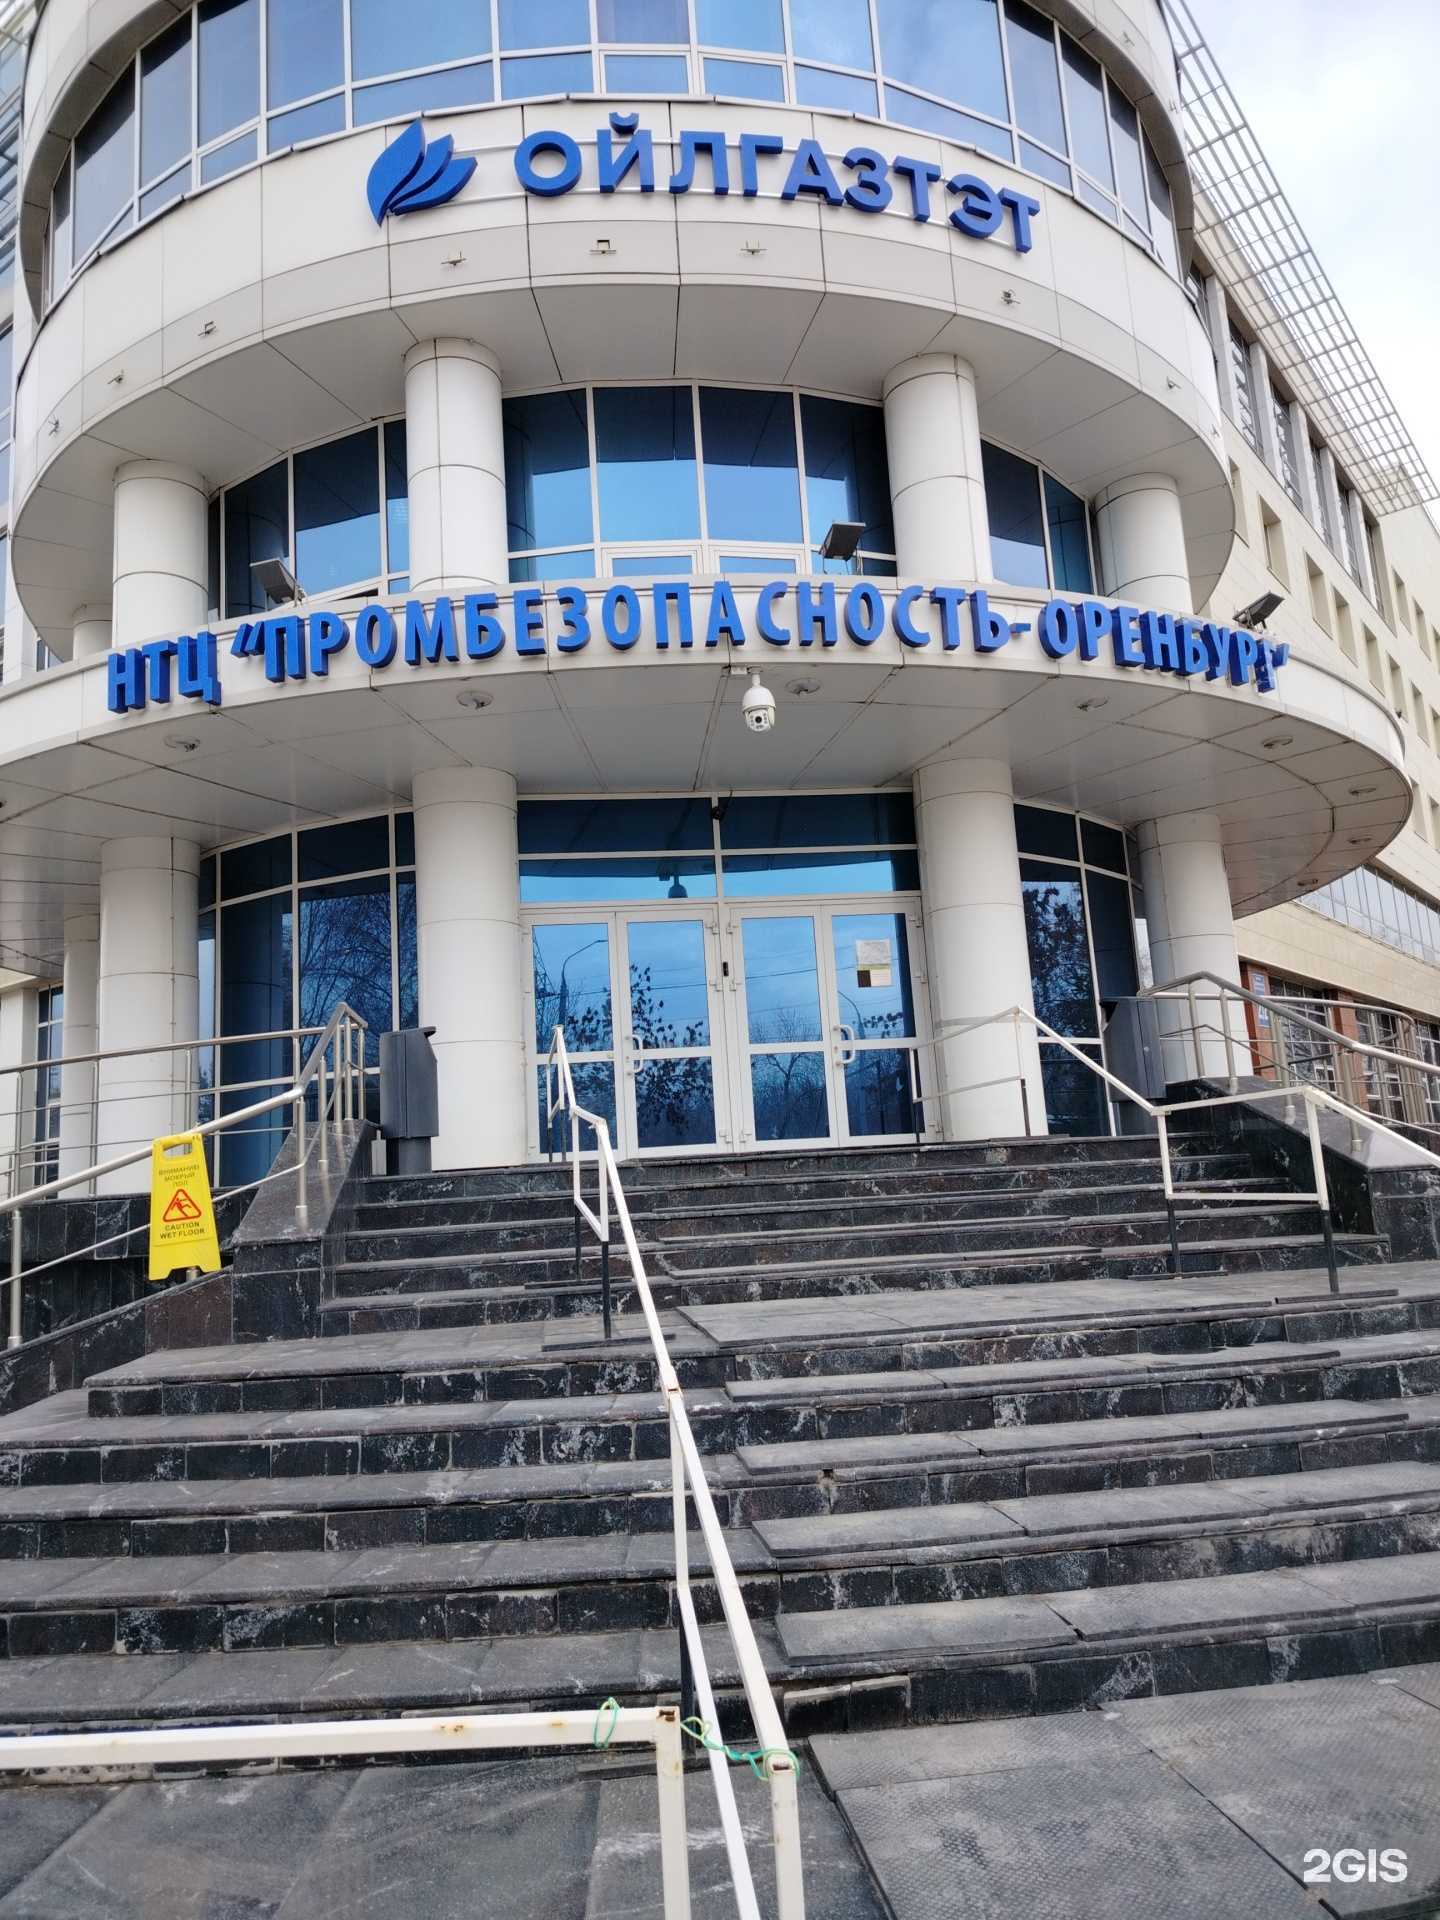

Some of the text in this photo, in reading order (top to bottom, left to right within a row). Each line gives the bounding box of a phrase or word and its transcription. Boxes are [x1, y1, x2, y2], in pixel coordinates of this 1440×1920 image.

[513, 112, 1040, 253] ОЙЛГАЗТЭТ
[107, 631, 221, 714] НТЦ
[160, 1228, 205, 1239] WET FLOOR
[164, 1221, 200, 1231] CAUTION
